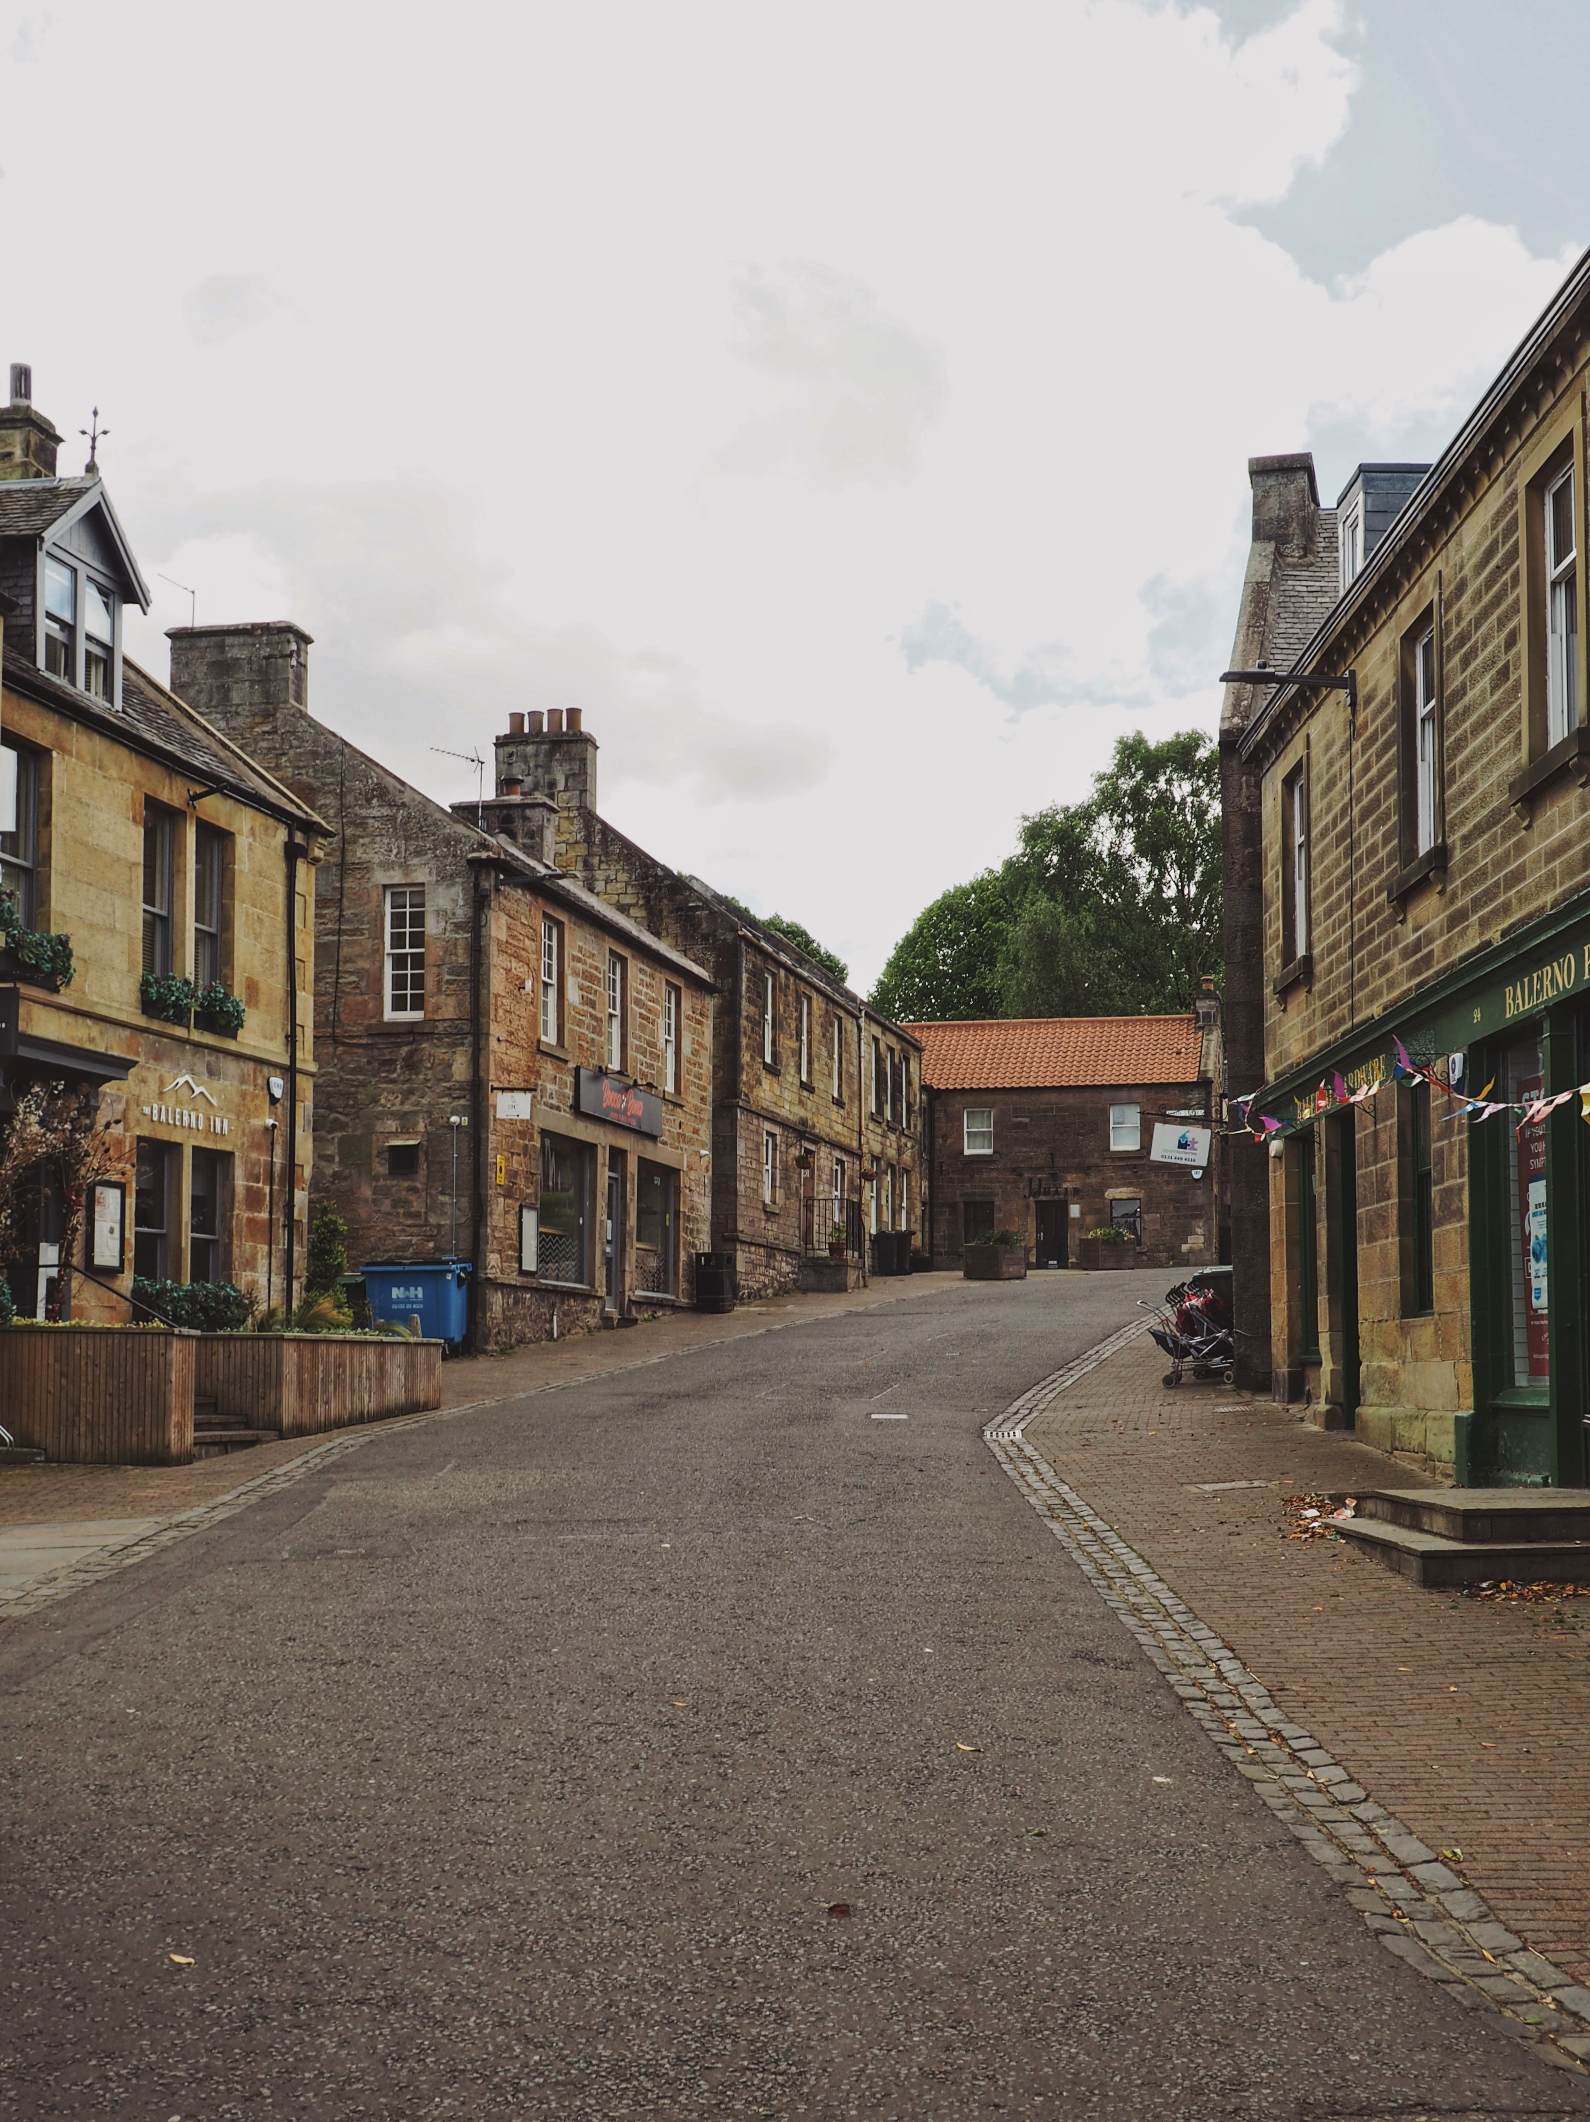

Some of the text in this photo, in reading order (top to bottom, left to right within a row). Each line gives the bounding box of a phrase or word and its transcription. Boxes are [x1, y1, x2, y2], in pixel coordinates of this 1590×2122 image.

[1504, 952, 1576, 1019] BALERNO
[152, 1103, 204, 1131] BALERNO
[210, 1116, 229, 1136] INN
